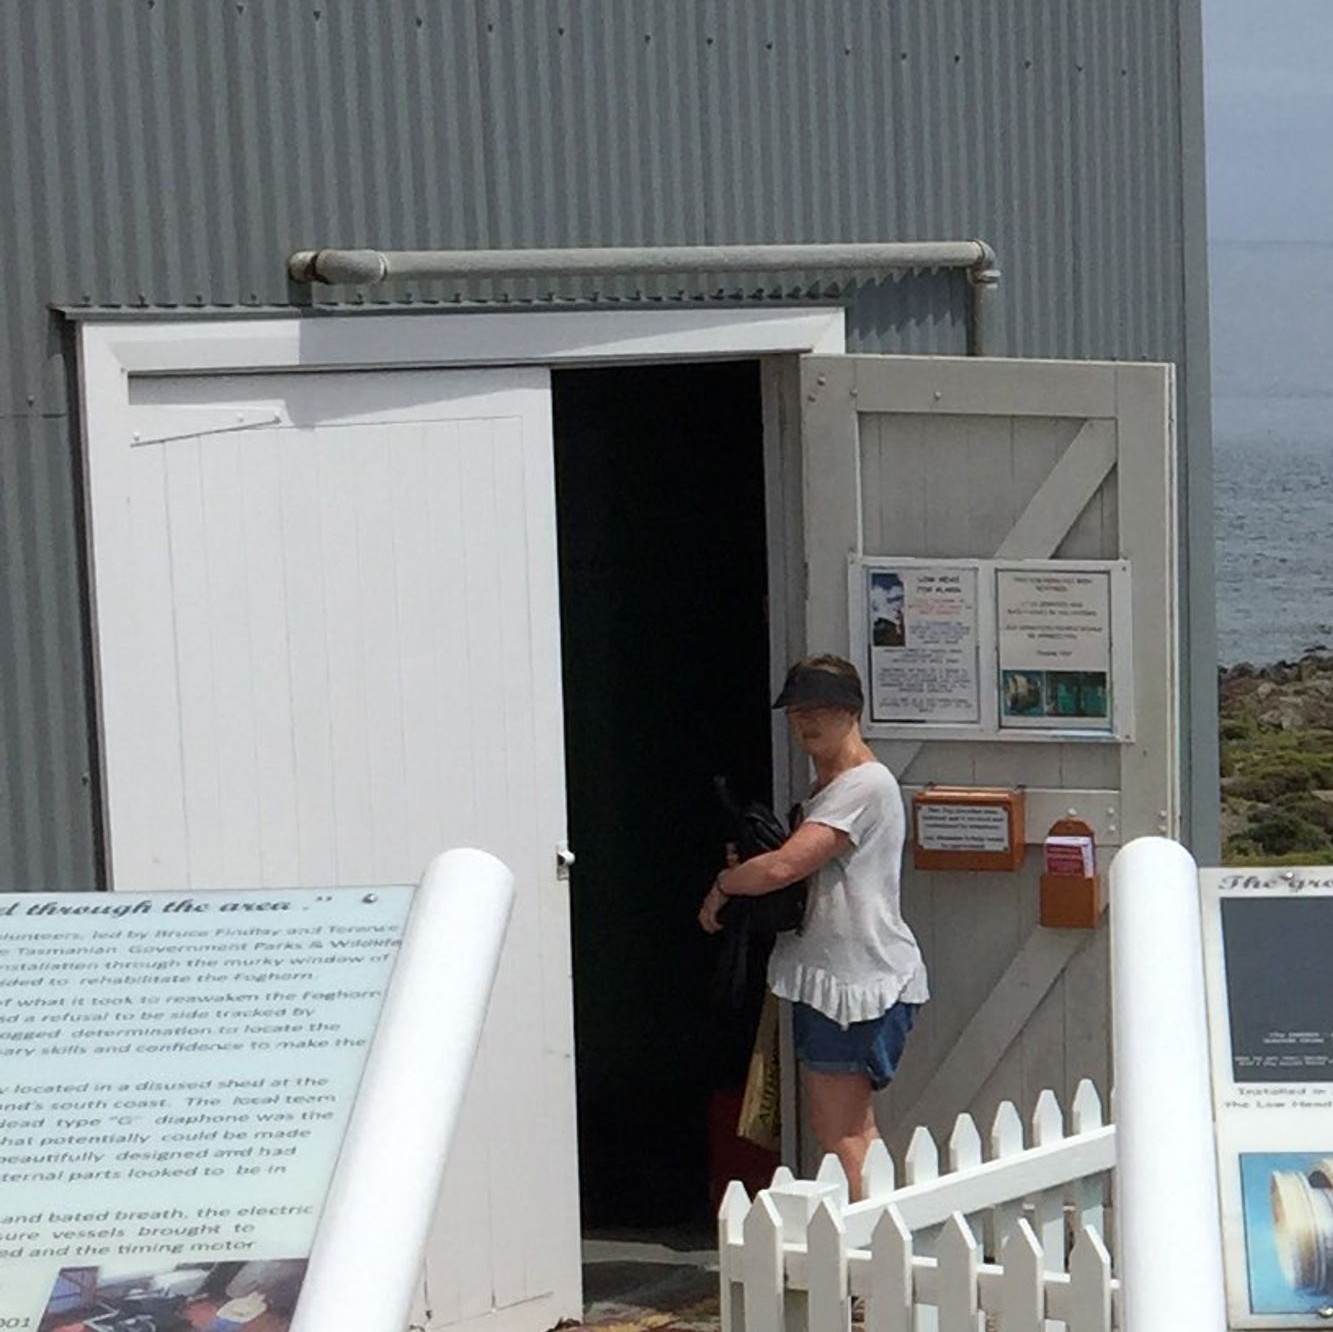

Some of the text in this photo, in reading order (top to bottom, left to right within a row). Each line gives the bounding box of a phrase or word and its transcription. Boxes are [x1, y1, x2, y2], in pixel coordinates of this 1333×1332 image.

[1219, 874, 1276, 890] The
[26, 899, 152, 918] through
[162, 898, 210, 913] the
[219, 901, 291, 912] area
[0, 930, 84, 942] lunteers,
[92, 929, 122, 940] led
[127, 929, 148, 941] by
[286, 925, 322, 935] and
[18, 945, 118, 956] Tasmanian
[128, 943, 248, 955] Government
[254, 941, 303, 952] Parks
[0, 952, 391, 973] stallation through the murky window of
[49, 976, 70, 986] to
[79, 973, 192, 986] rehabilitate
[197, 972, 229, 983] the
[17, 996, 66, 1008] what
[71, 996, 85, 1007] it
[91, 995, 135, 1006] took
[140, 995, 161, 1004] to
[166, 993, 260, 1005] reawaken
[265, 991, 298, 1001] the
[41, 1011, 110, 1023] refusal
[115, 1011, 135, 1021] to
[141, 1010, 165, 1021] be
[170, 1008, 210, 1019] side
[215, 1006, 287, 1018] tracked
[291, 1006, 316, 1018] by
[71, 1025, 212, 1039] determination
[219, 1025, 239, 1035] to
[244, 1023, 304, 1034] locate
[309, 1021, 341, 1032] the
[41, 1044, 87, 1056] skills
[94, 1043, 132, 1054] and
[136, 1041, 244, 1054] confidence
[250, 1041, 271, 1050] to
[275, 1038, 330, 1050] make
[335, 1037, 367, 1048] the
[14, 1081, 89, 1094] located
[93, 1083, 112, 1092] in
[135, 1079, 212, 1092] disused
[218, 1077, 265, 1090] shed
[270, 1077, 289, 1088] at
[295, 1076, 330, 1087] the
[50, 1099, 108, 1110] south
[187, 1096, 222, 1107] The
[232, 1094, 281, 1106] local
[285, 1094, 337, 1105] team
[56, 1117, 102, 1130] type
[153, 1112, 250, 1126] diaphone
[256, 1113, 295, 1123] was
[301, 1110, 335, 1121] the
[40, 1132, 152, 1147] potentially
[161, 1129, 219, 1142] could
[223, 1129, 248, 1140] be
[253, 1128, 312, 1140] made
[115, 1149, 209, 1162] designed
[213, 1146, 254, 1159] and
[258, 1145, 297, 1157] had
[68, 1169, 122, 1182] parts
[127, 1166, 199, 1179] looked
[204, 1166, 225, 1177] to
[236, 1165, 263, 1176] be
[267, 1164, 287, 1175] in
[0, 1213, 43, 1224] and
[48, 1210, 109, 1223] bated
[197, 1207, 231, 1218] the
[237, 1205, 313, 1217] electric
[52, 1227, 125, 1239] vessels
[138, 1225, 221, 1238] brought
[234, 1223, 256, 1234] to
[28, 1245, 71, 1258] and
[75, 1244, 111, 1256] the
[118, 1242, 185, 1255] timing
[190, 1240, 256, 1253] motor
